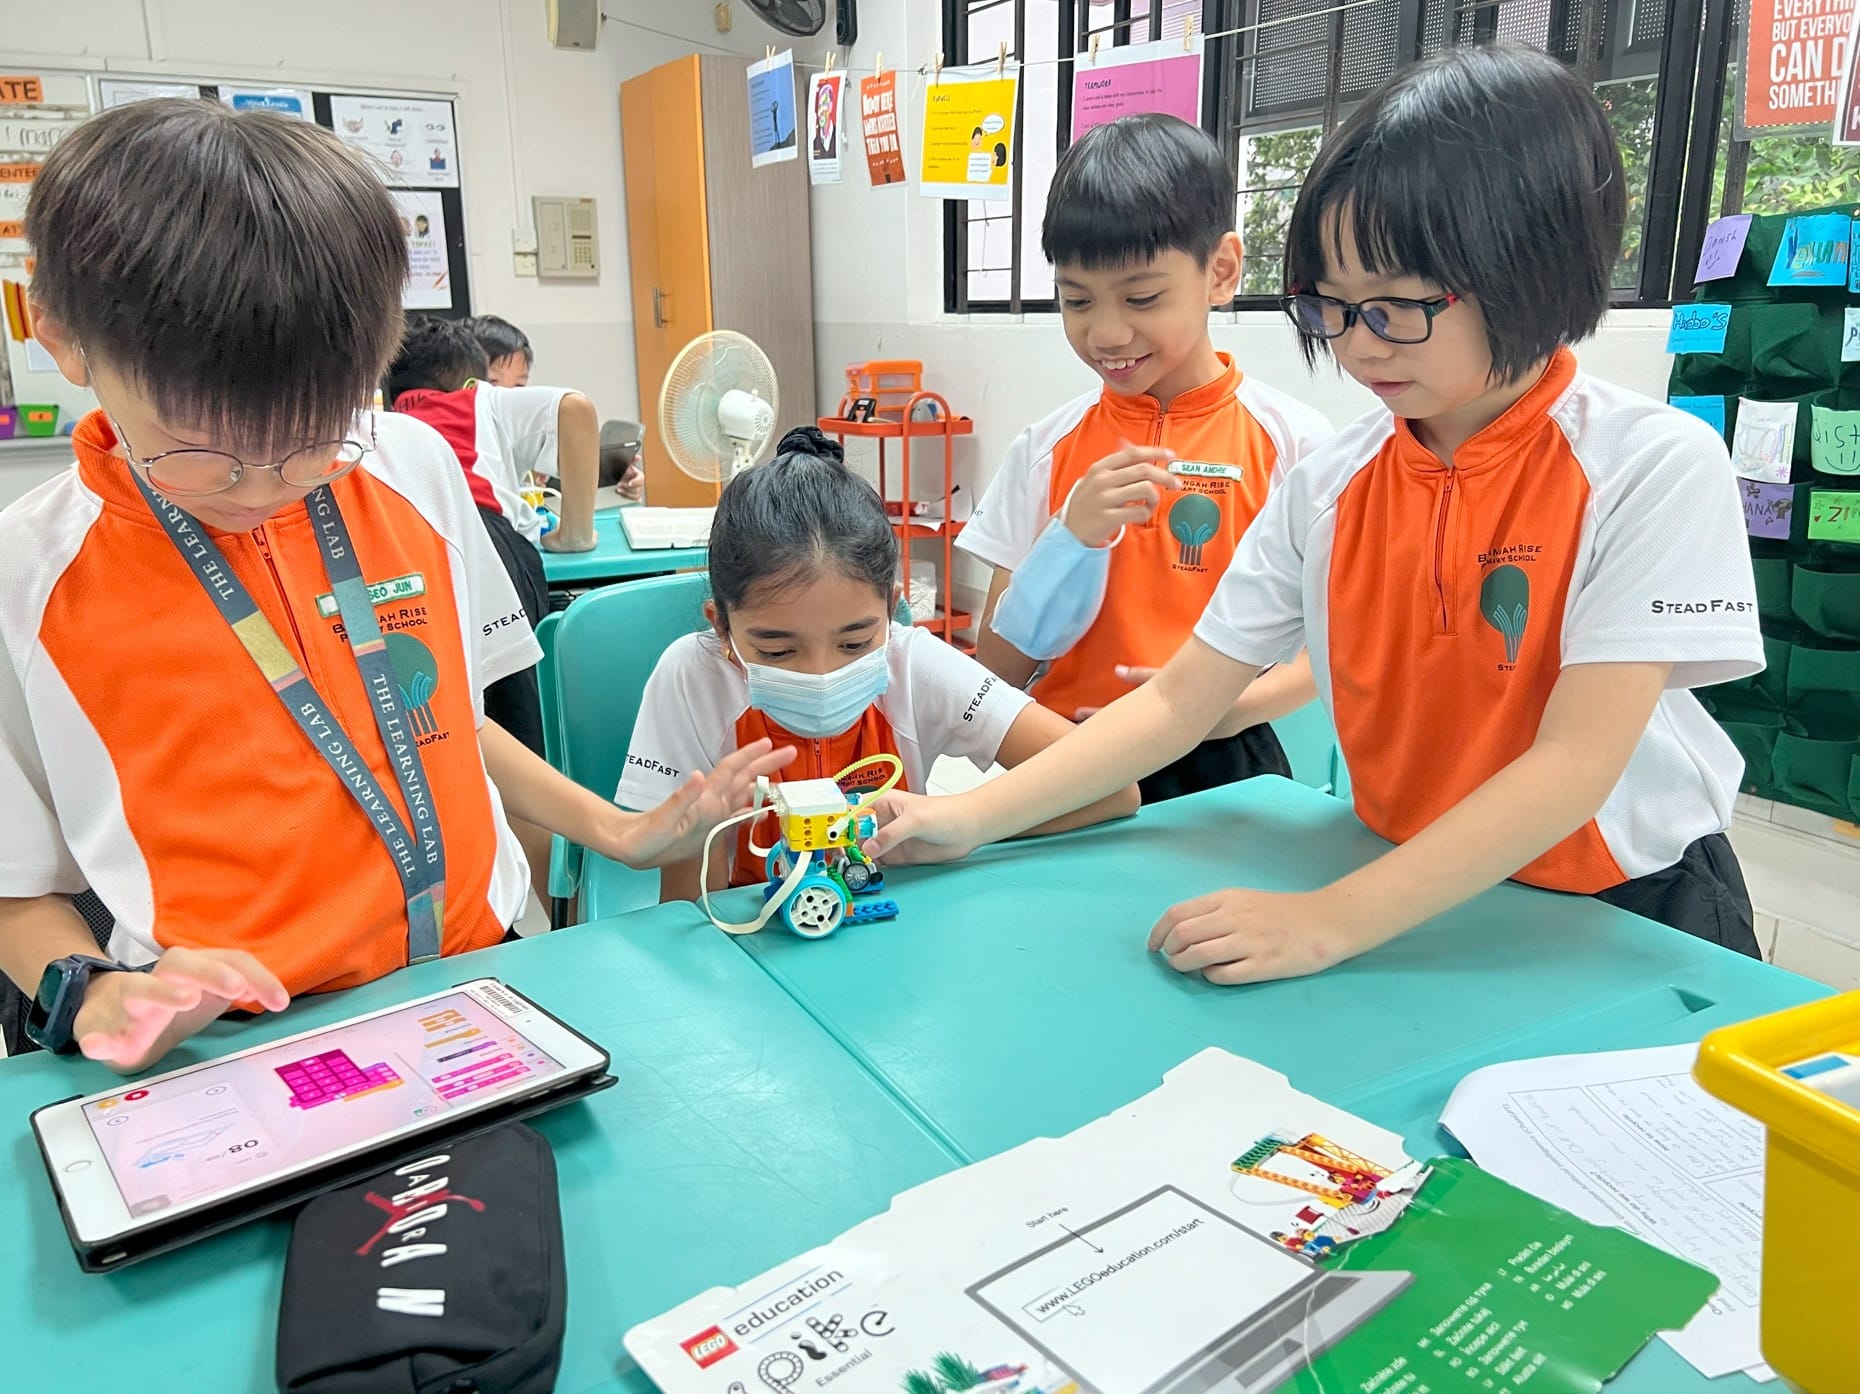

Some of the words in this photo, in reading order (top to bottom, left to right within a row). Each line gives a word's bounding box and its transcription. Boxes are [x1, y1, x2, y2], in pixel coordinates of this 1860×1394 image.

[1772, 20, 1797, 42] BUT
[1800, 13, 1852, 38] EVERYO
[1770, 38, 1823, 83] CAN
[1769, 79, 1840, 110] SOMETH
[322, 521, 345, 560] LAB
[1518, 544, 1543, 553] RISE
[202, 560, 235, 601] THE
[393, 580, 413, 595] JUN
[387, 617, 428, 631] SCHOOL
[399, 607, 428, 618] RISE
[301, 702, 332, 740] LAB
[328, 741, 397, 834] LEARNING
[373, 673, 395, 713] THE
[387, 718, 430, 821] LEARNING
[422, 824, 438, 864] LAB
[392, 837, 417, 878] THE
[1025, 1215, 1048, 1229] Start
[1047, 1206, 1069, 1219] here
[1036, 1217, 1205, 1314] www.LEGOeducation.com/start
[692, 1332, 728, 1359] LEGO
[733, 1268, 845, 1337] education
[816, 1349, 873, 1388] Essential
